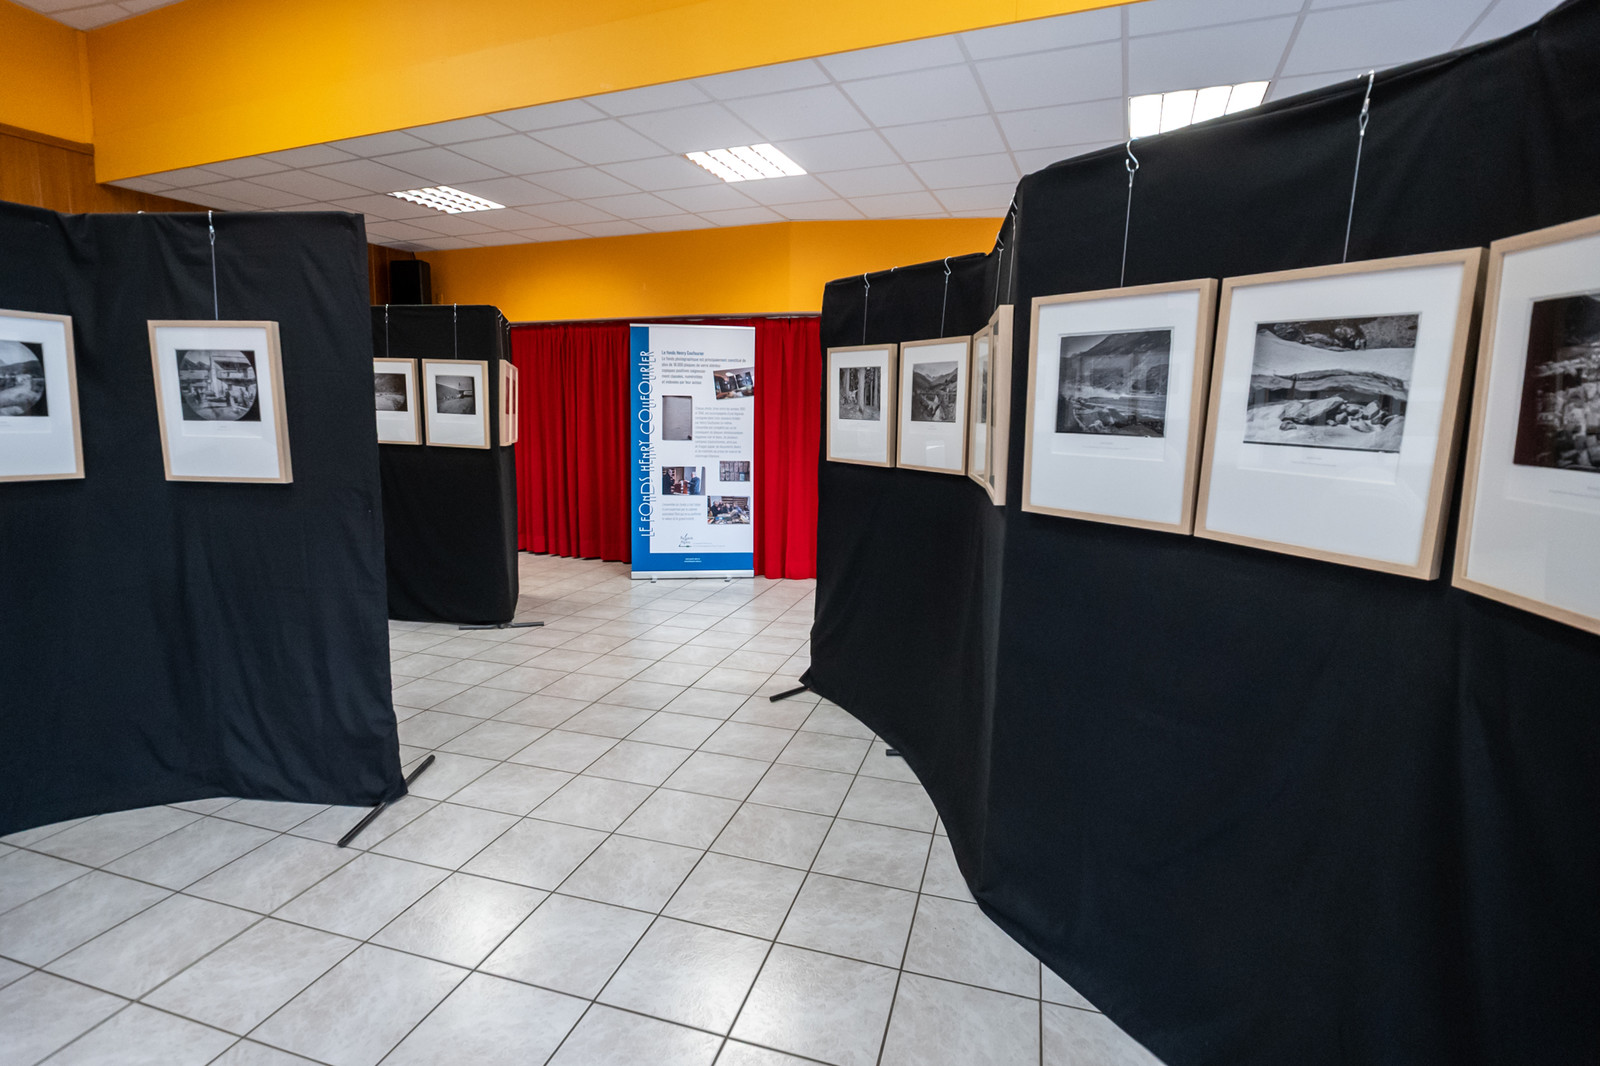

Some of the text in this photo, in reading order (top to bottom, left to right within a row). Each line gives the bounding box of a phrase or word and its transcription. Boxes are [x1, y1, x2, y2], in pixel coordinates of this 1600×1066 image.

[638, 350, 656, 537] LE FONDS HENRY COUFOURIER
